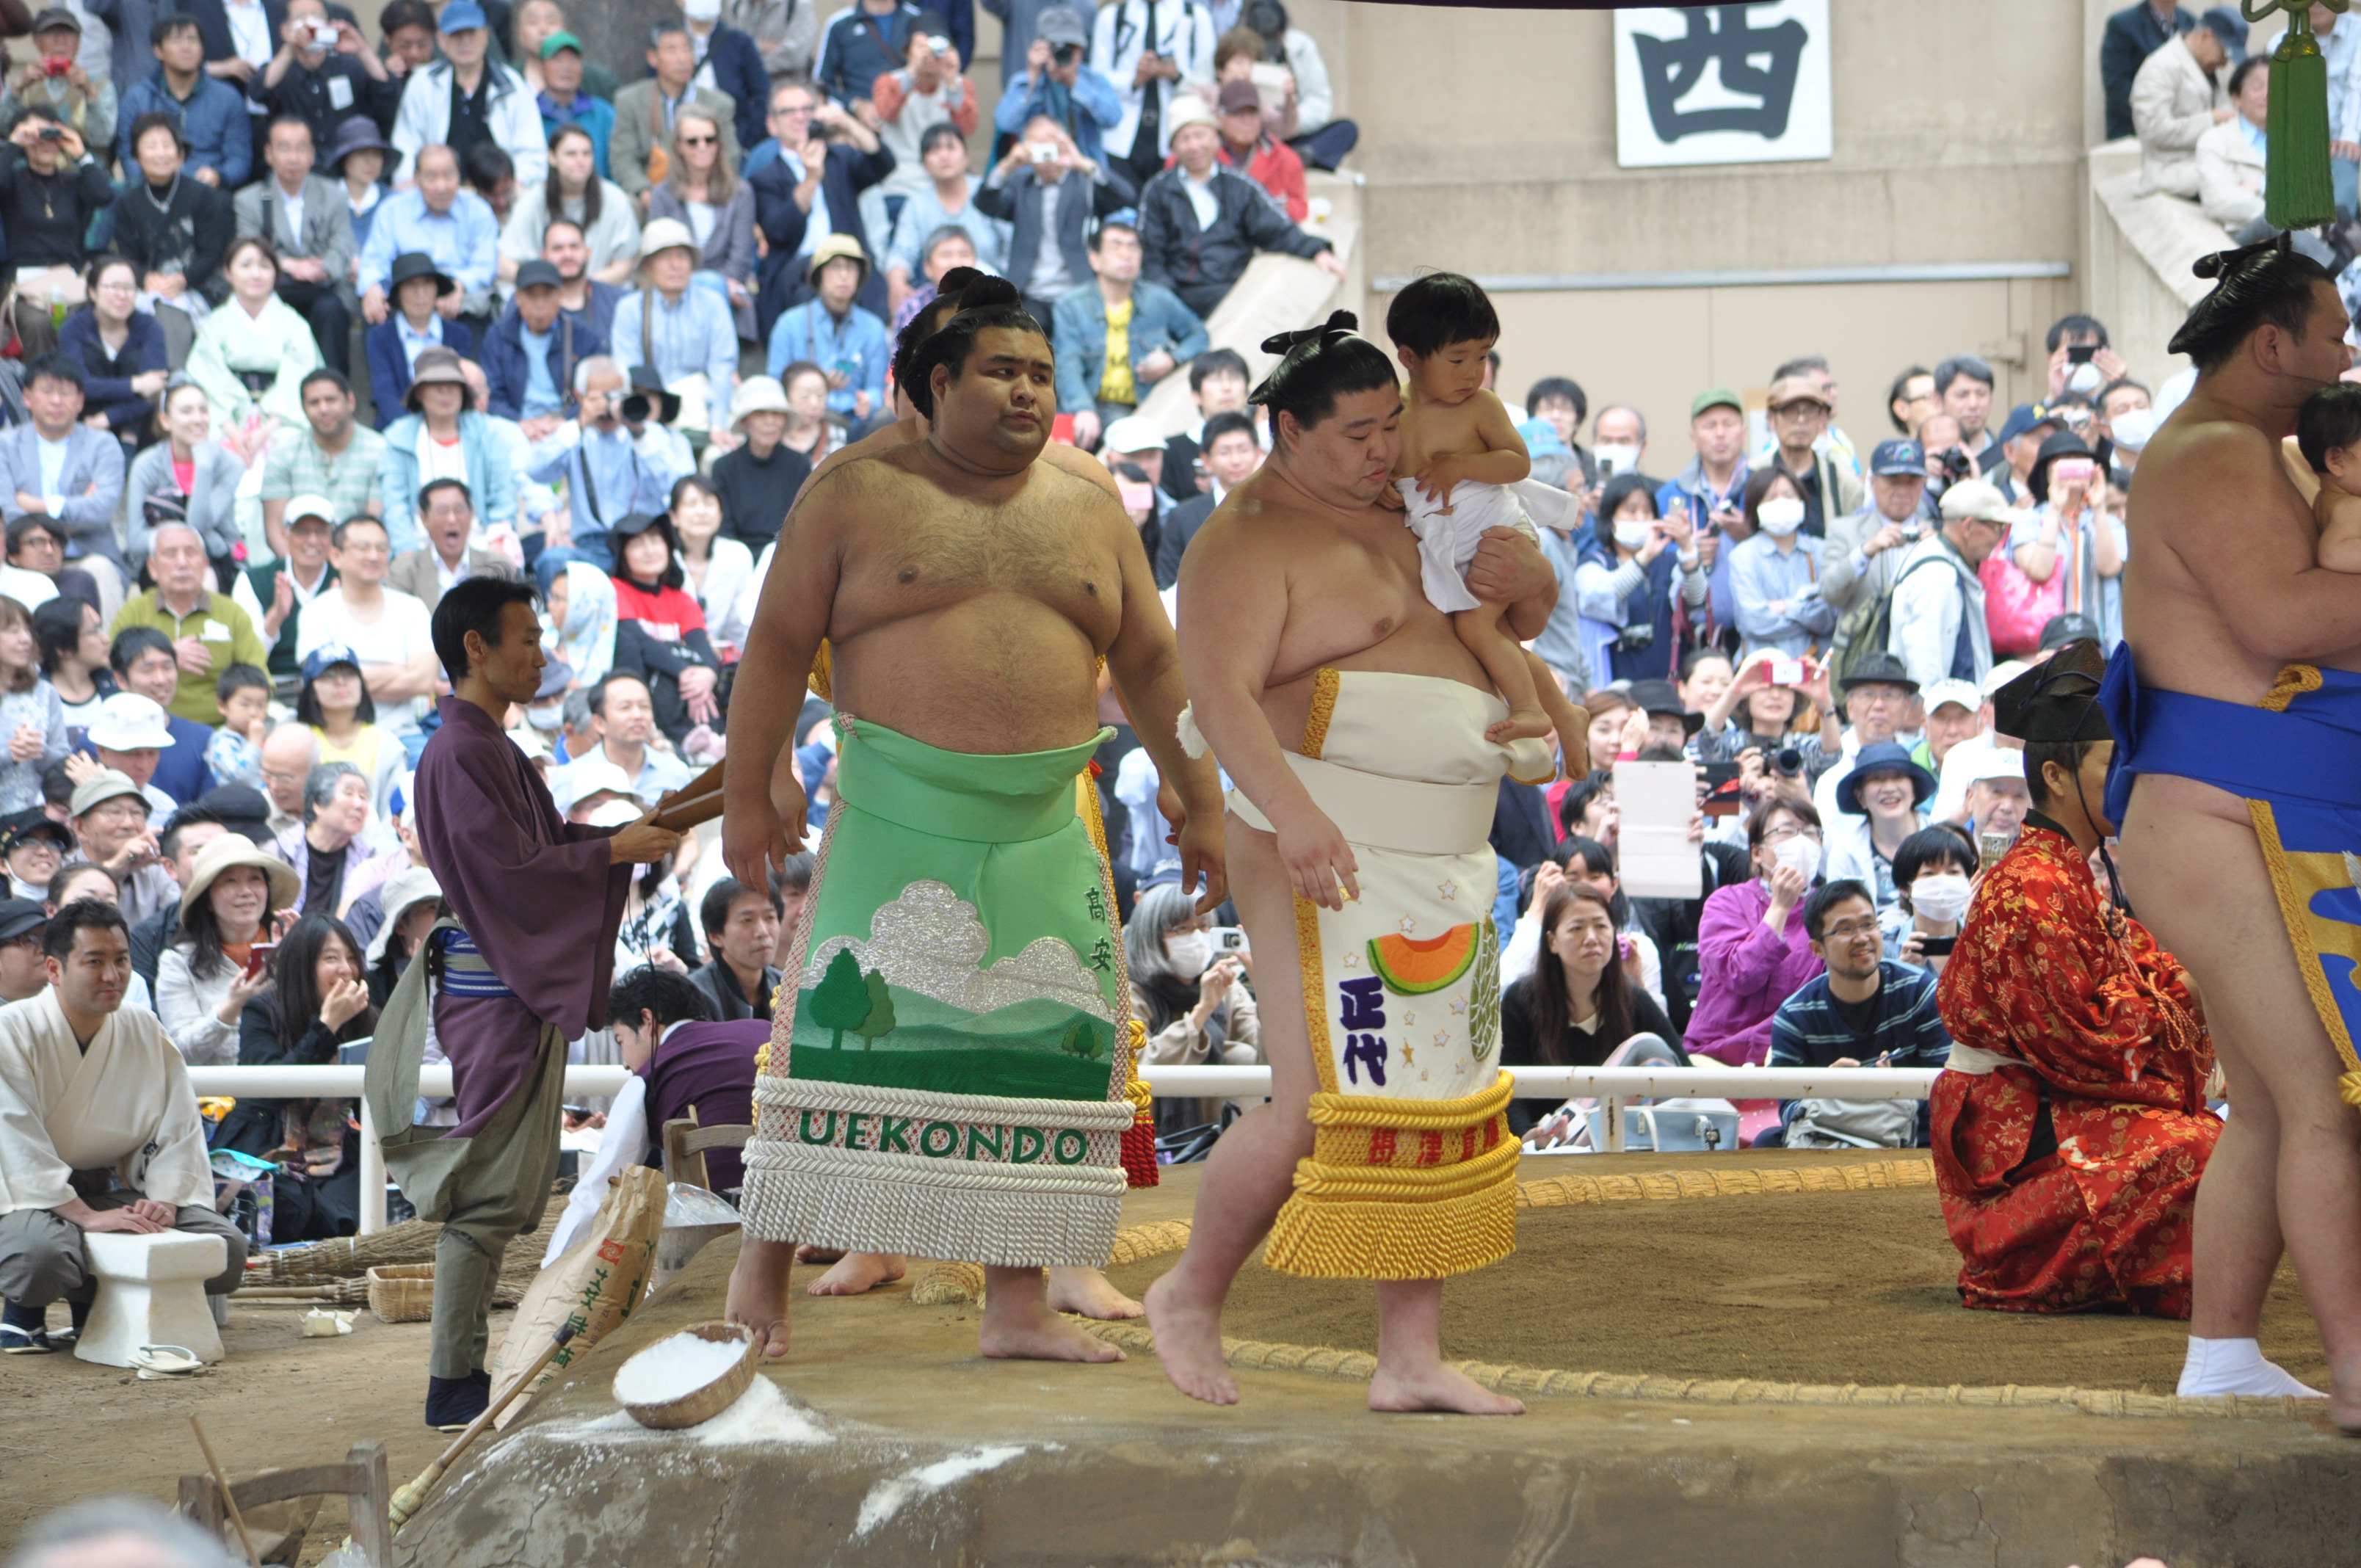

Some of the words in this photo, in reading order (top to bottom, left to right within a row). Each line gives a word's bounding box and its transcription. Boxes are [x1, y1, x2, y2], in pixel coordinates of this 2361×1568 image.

[1631, 1, 1809, 145] 西
[1339, 976, 1387, 1086] 正代
[799, 1110, 1087, 1166] UEKONDO
